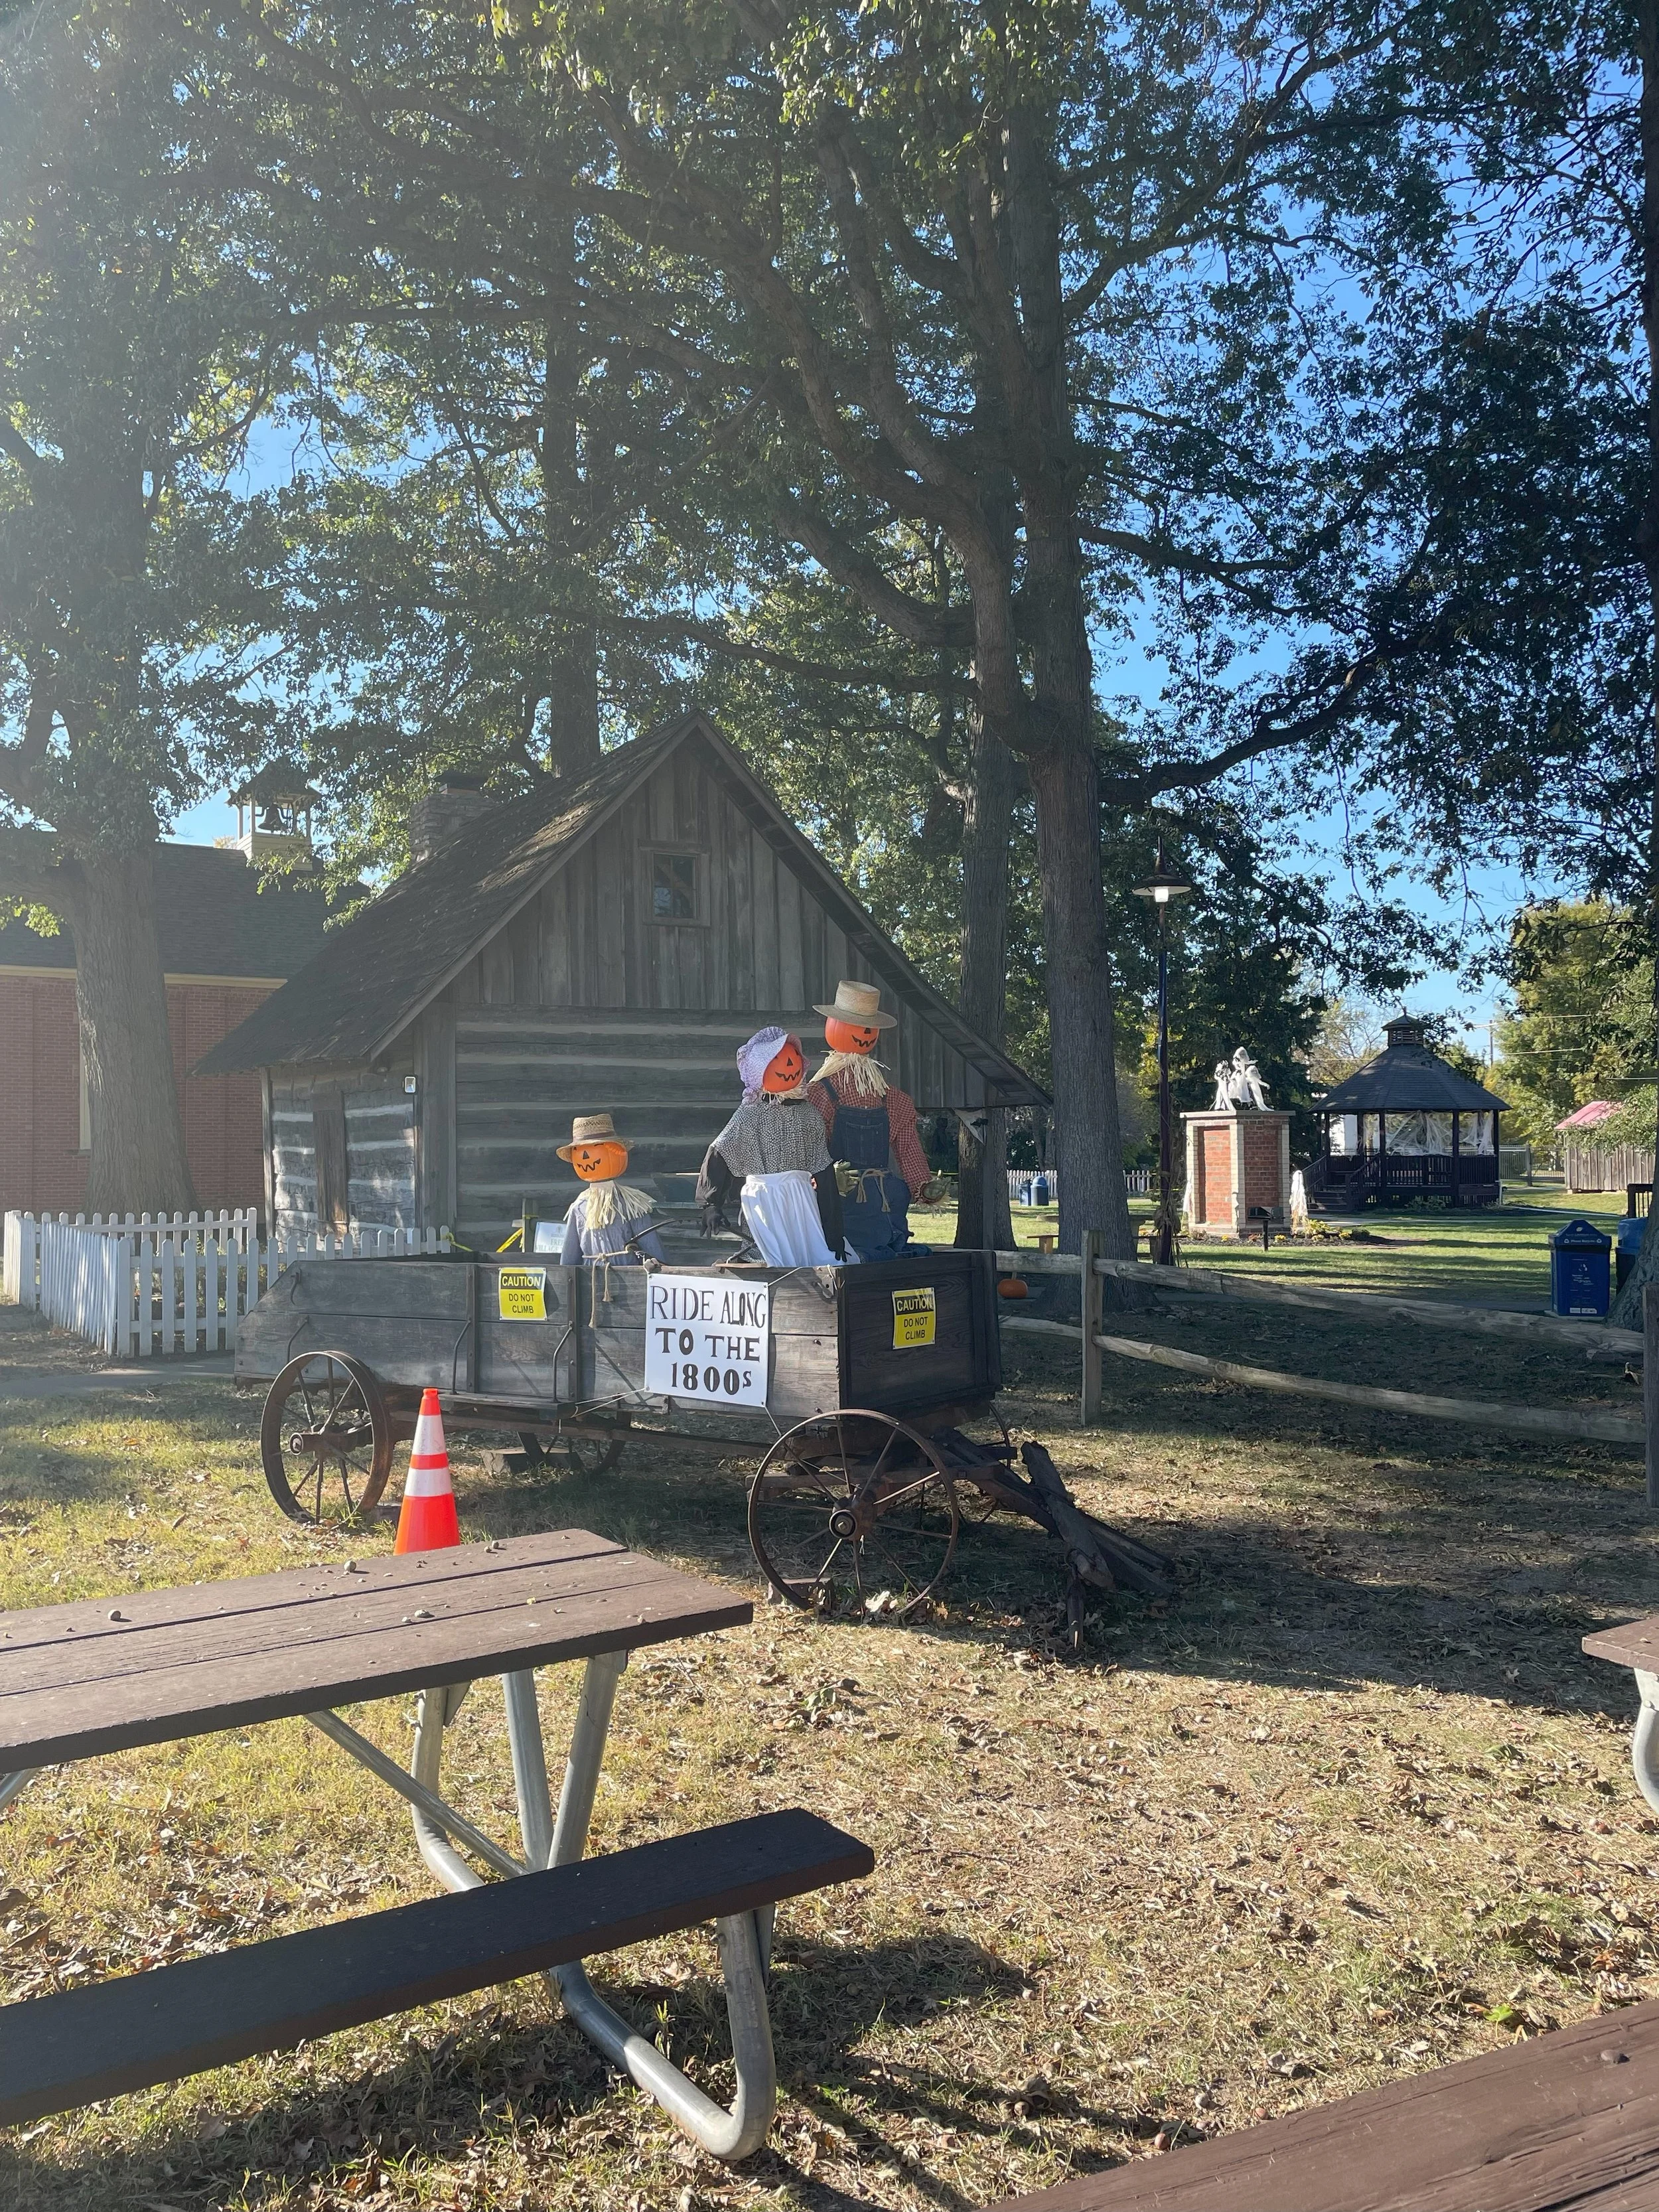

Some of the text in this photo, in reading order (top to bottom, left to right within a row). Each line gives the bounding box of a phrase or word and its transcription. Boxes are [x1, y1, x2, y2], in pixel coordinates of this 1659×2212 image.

[502, 1276, 541, 1287] CAUTION
[512, 1305, 534, 1313] CLIMB
[650, 1286, 766, 1328] RIDE ALONG
[897, 1296, 932, 1311] CAUTION
[904, 1317, 928, 1327] DO NOT
[905, 1329, 925, 1340] CLIMB
[655, 1327, 760, 1362] TO THE
